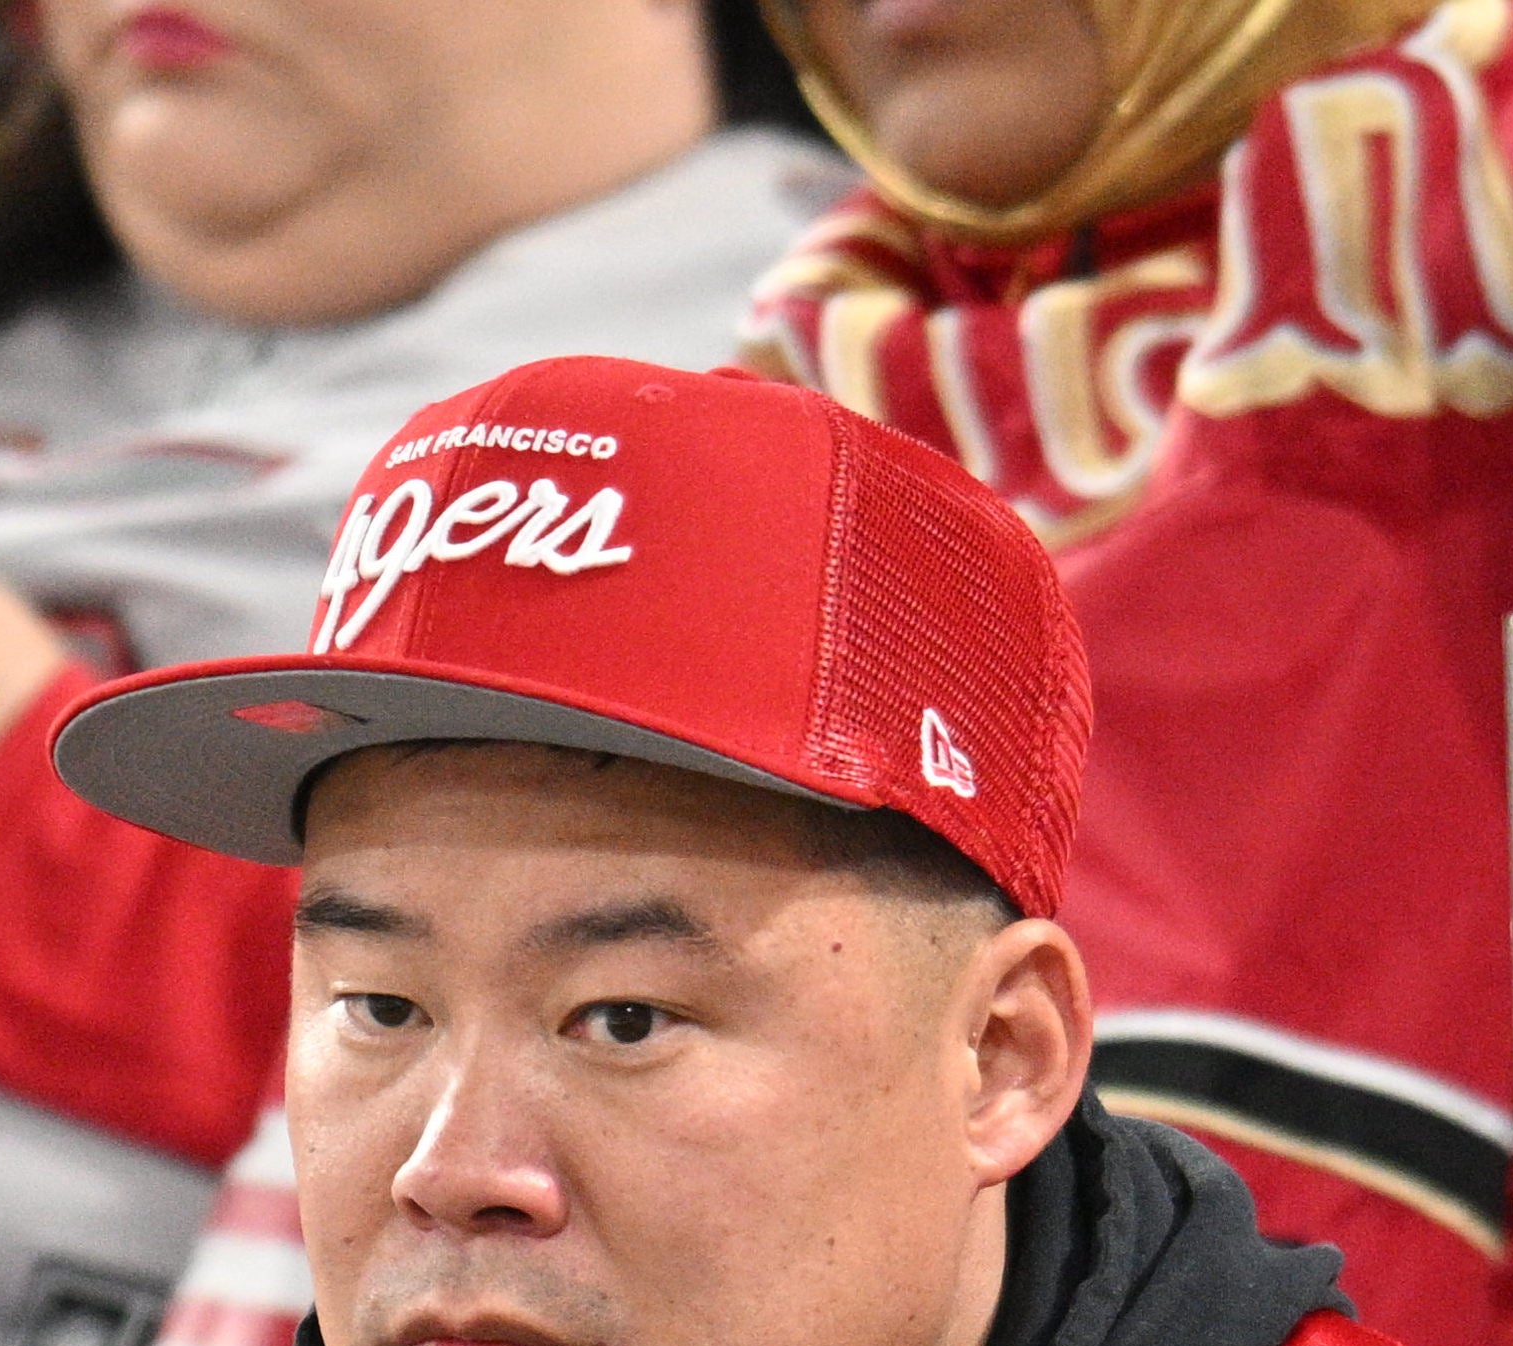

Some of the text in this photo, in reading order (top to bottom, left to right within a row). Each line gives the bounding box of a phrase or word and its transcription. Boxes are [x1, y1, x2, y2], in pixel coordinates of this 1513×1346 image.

[386, 423, 618, 468] SAN FRANCISCO
[313, 477, 633, 655] 49ers
